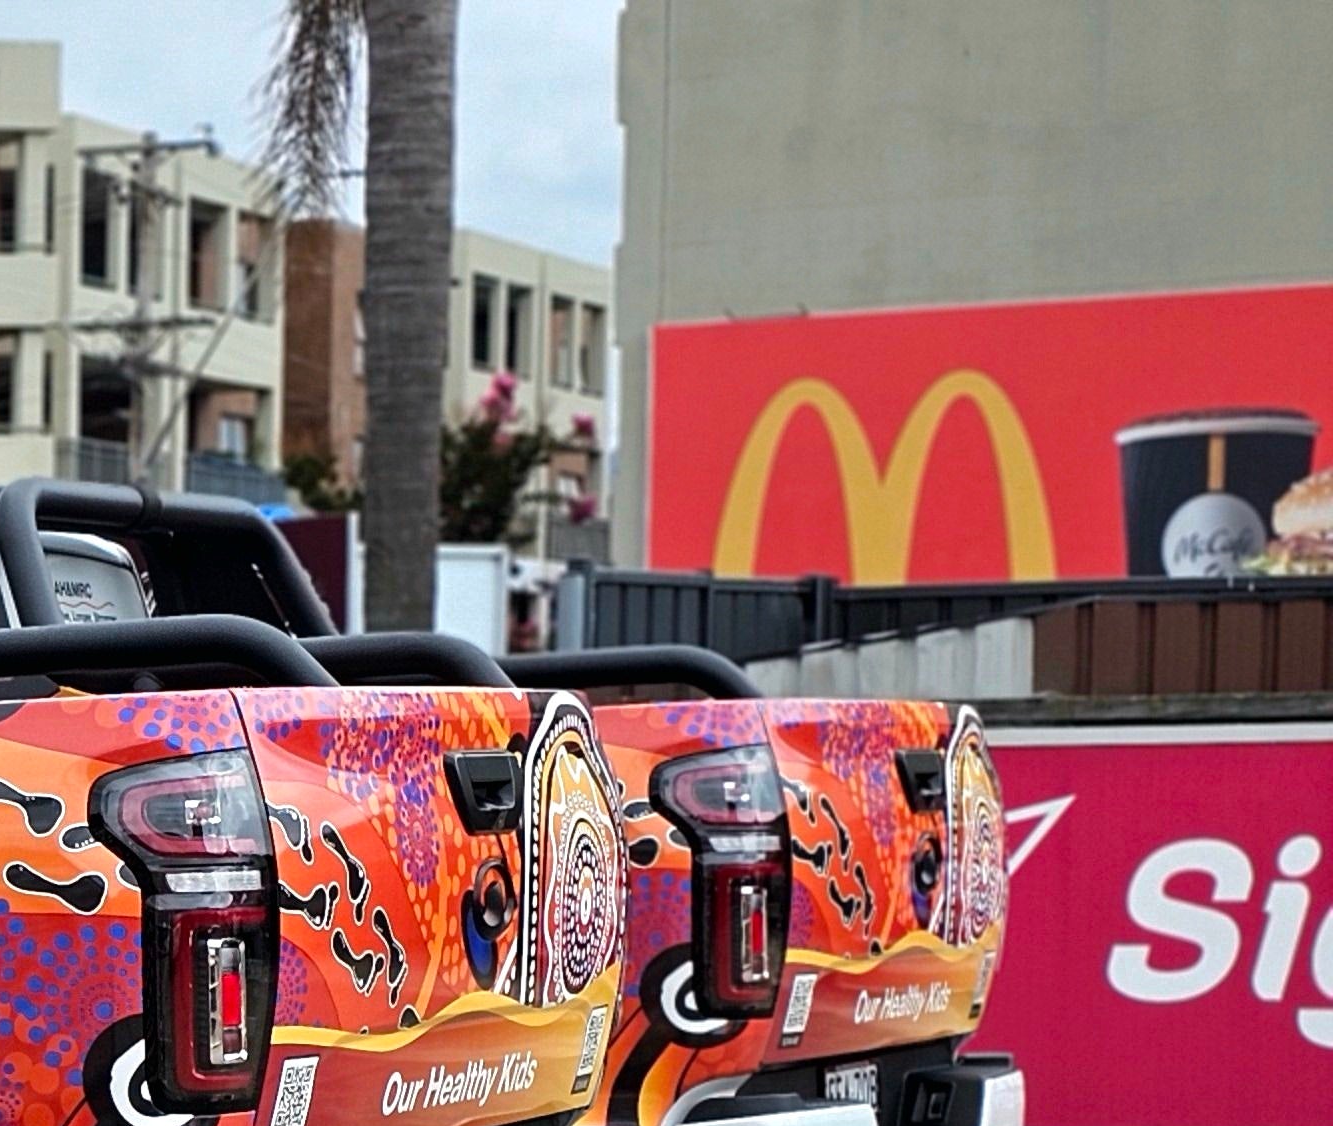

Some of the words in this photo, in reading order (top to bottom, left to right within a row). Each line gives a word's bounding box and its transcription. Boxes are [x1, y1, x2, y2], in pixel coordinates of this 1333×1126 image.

[1106, 834, 1333, 1048] Si
[854, 988, 882, 1024] Our
[382, 1071, 425, 1116] Our
[422, 1057, 498, 1109] Healthy
[498, 1050, 539, 1093] Kids
